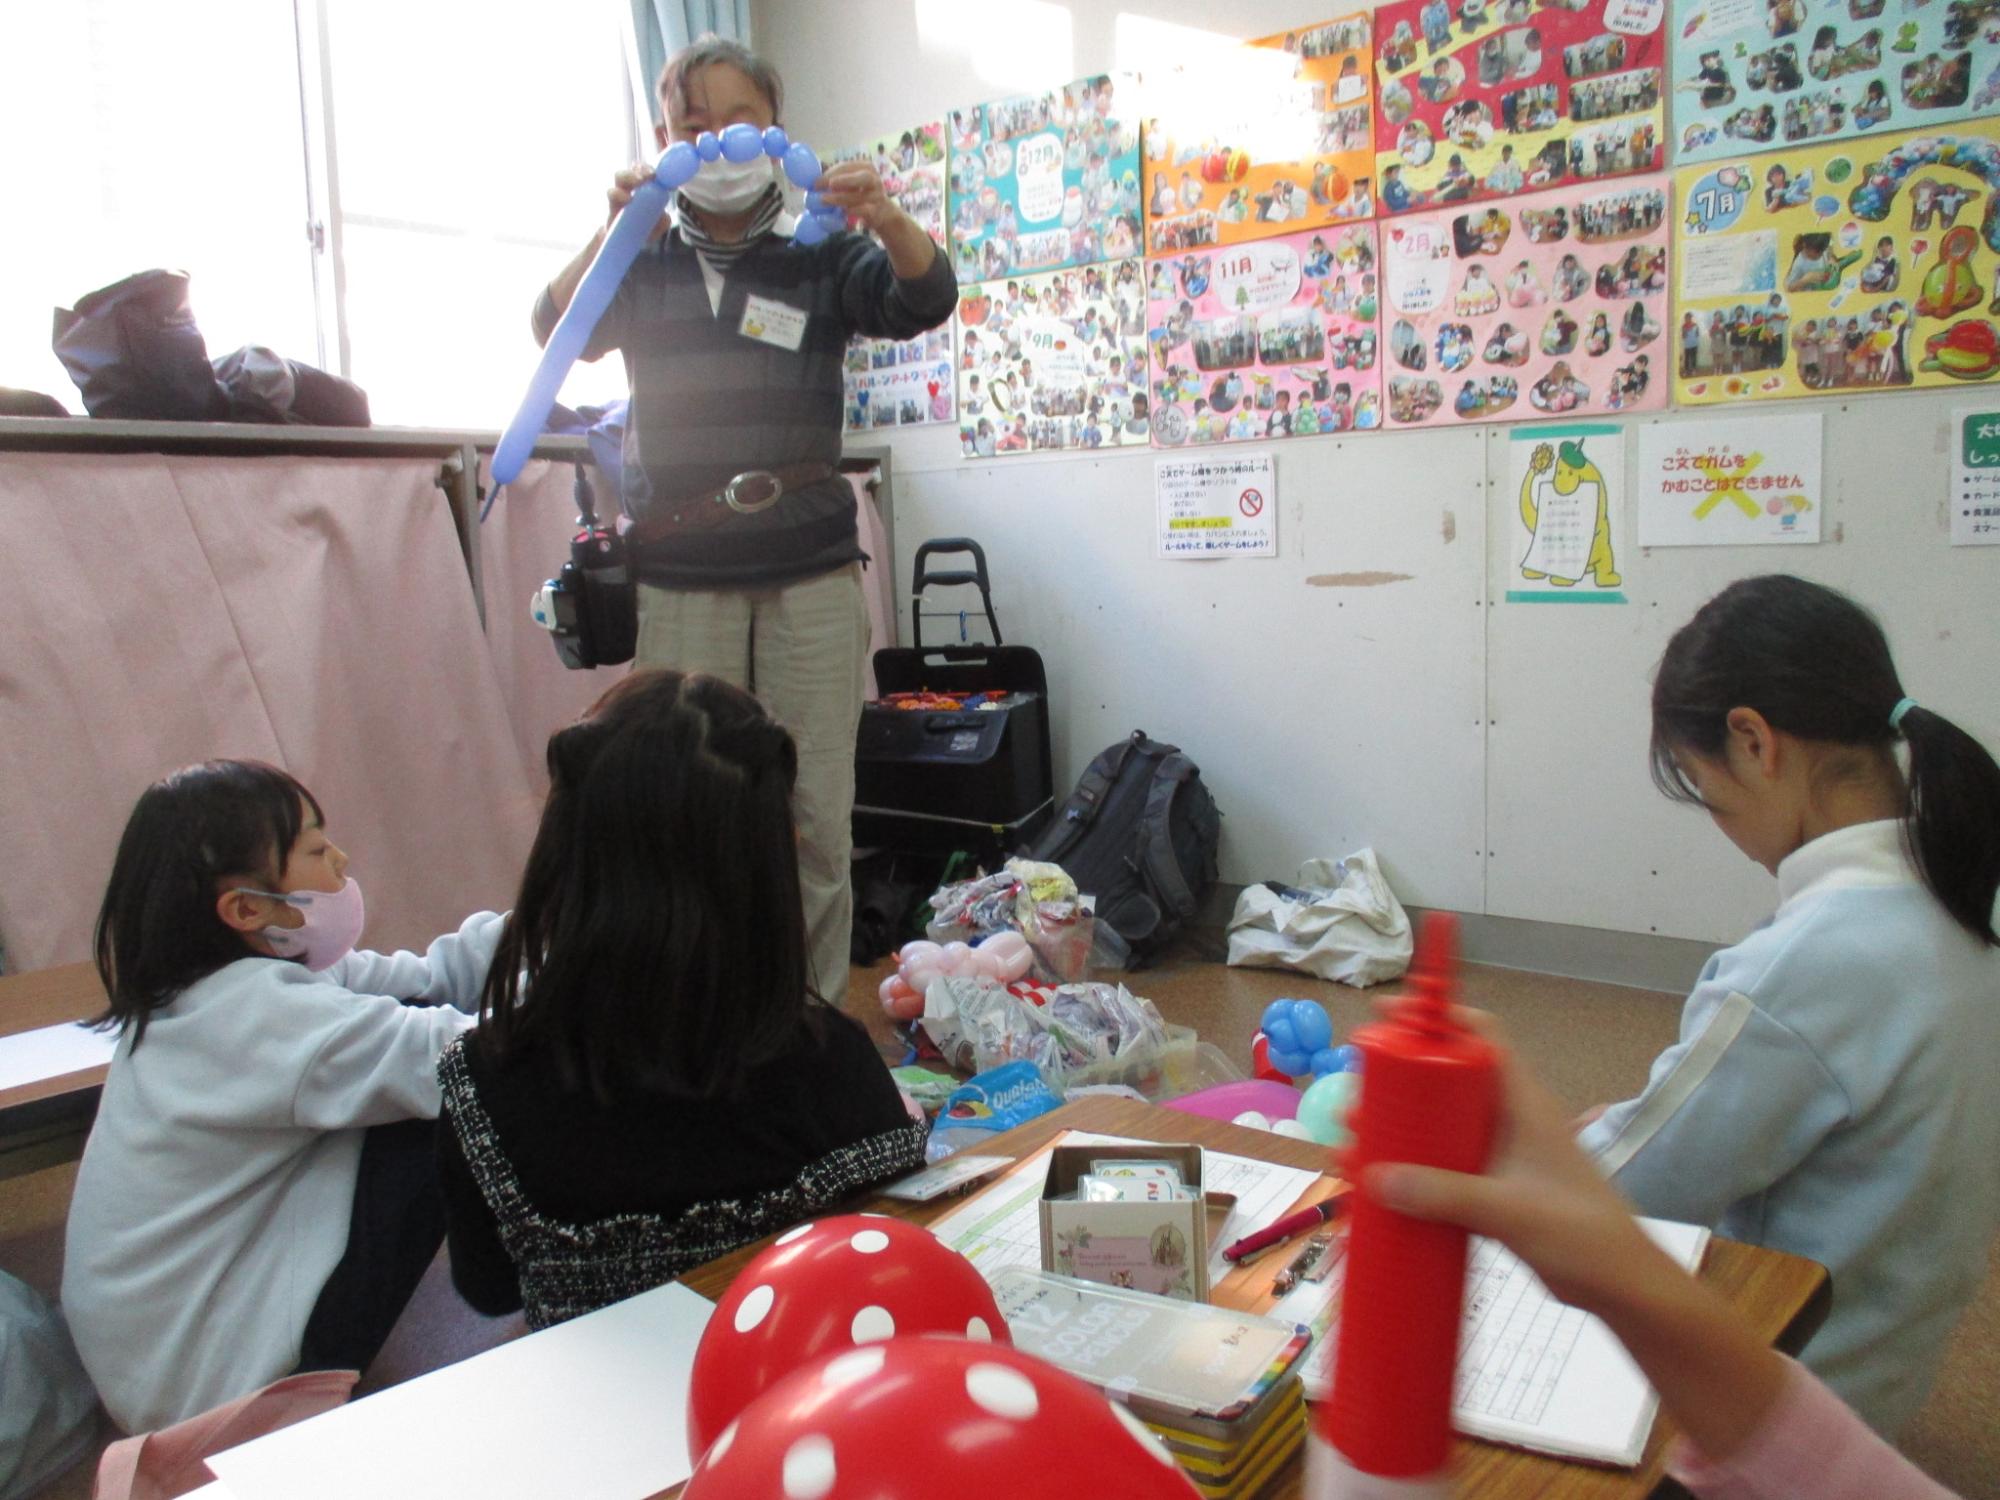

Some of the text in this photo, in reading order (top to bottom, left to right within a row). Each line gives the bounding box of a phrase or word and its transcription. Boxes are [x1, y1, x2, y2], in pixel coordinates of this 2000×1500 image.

[1696, 189, 1735, 221] 7月
[1406, 233, 1430, 254] 2月
[1221, 256, 1252, 279] 11月
[1033, 333, 1053, 349] 9月
[1662, 454, 1746, 471] こ文でガムを
[1662, 475, 1804, 493] かむことはできません
[1042, 1302, 1125, 1358] COLOR
